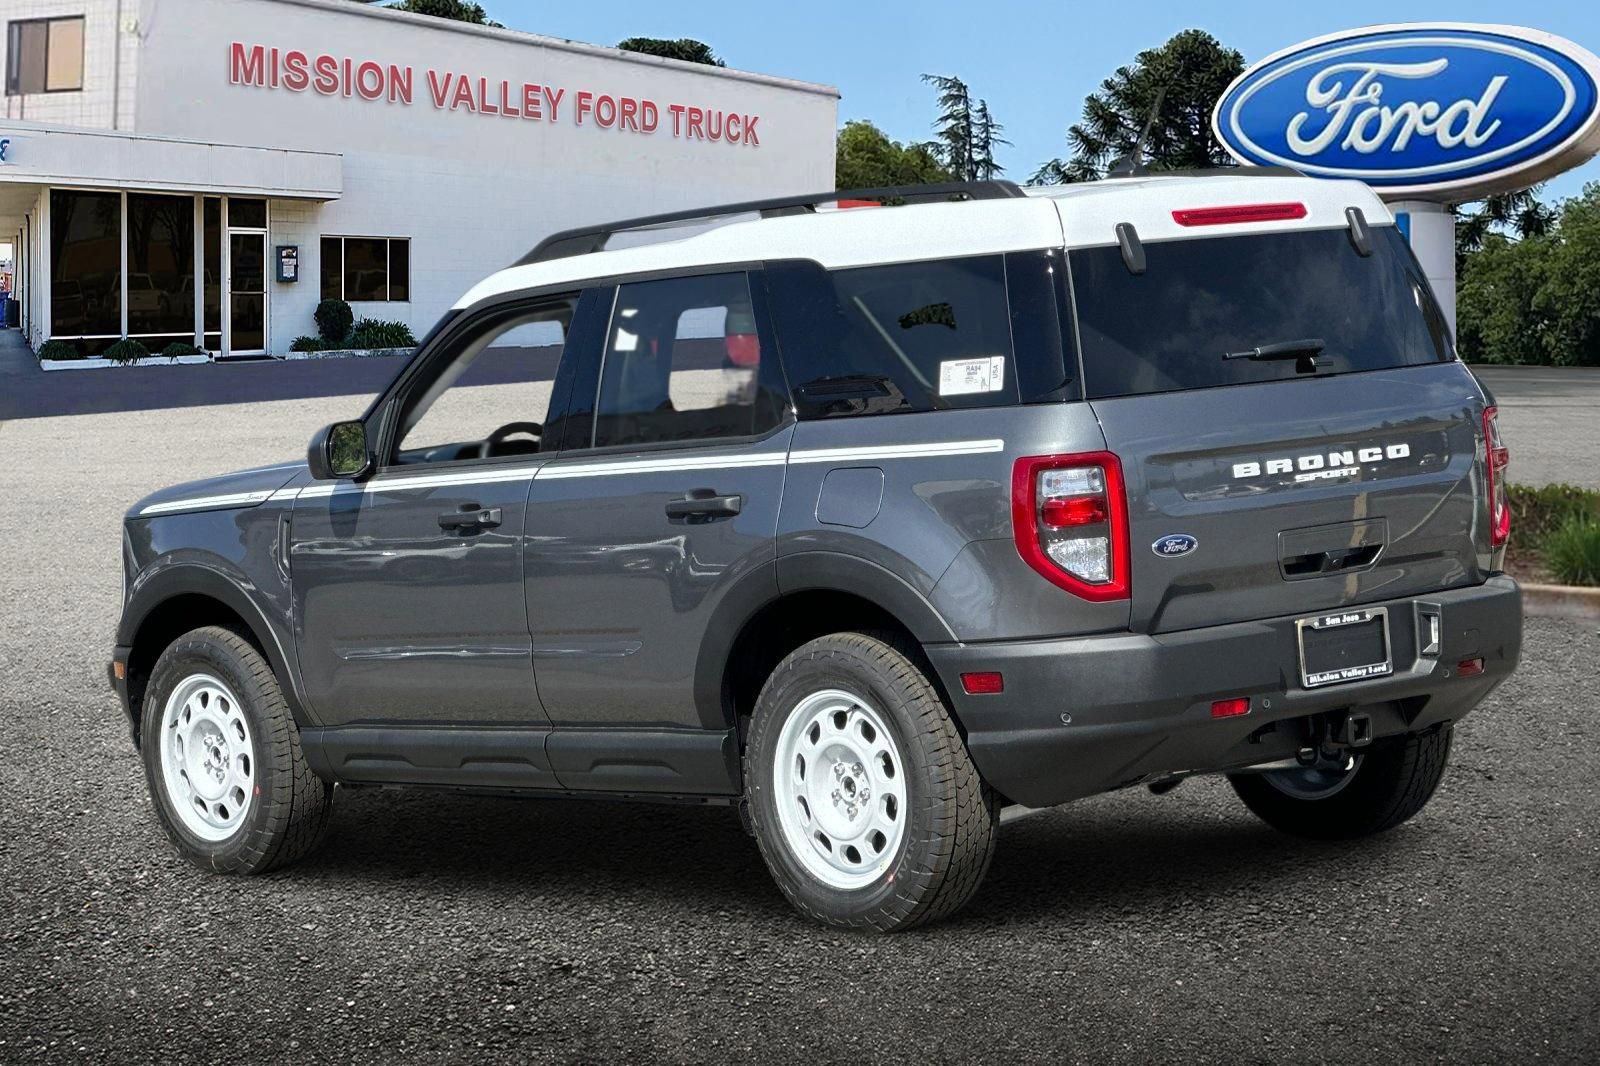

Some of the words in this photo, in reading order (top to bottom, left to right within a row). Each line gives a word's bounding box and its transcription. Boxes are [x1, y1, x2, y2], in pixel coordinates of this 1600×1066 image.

[229, 41, 412, 105] MISSION
[427, 69, 565, 122] VALLEY
[576, 90, 660, 134] FORD
[669, 104, 761, 146] TRUCK
[1286, 58, 1509, 156] Ford
[991, 364, 999, 379] USA
[1232, 443, 1411, 478] BRONCO
[1295, 466, 1361, 483] SPORT
[1164, 539, 1189, 553] Ford
[1325, 616, 1341, 626] San
[1340, 667, 1367, 679] Valley
